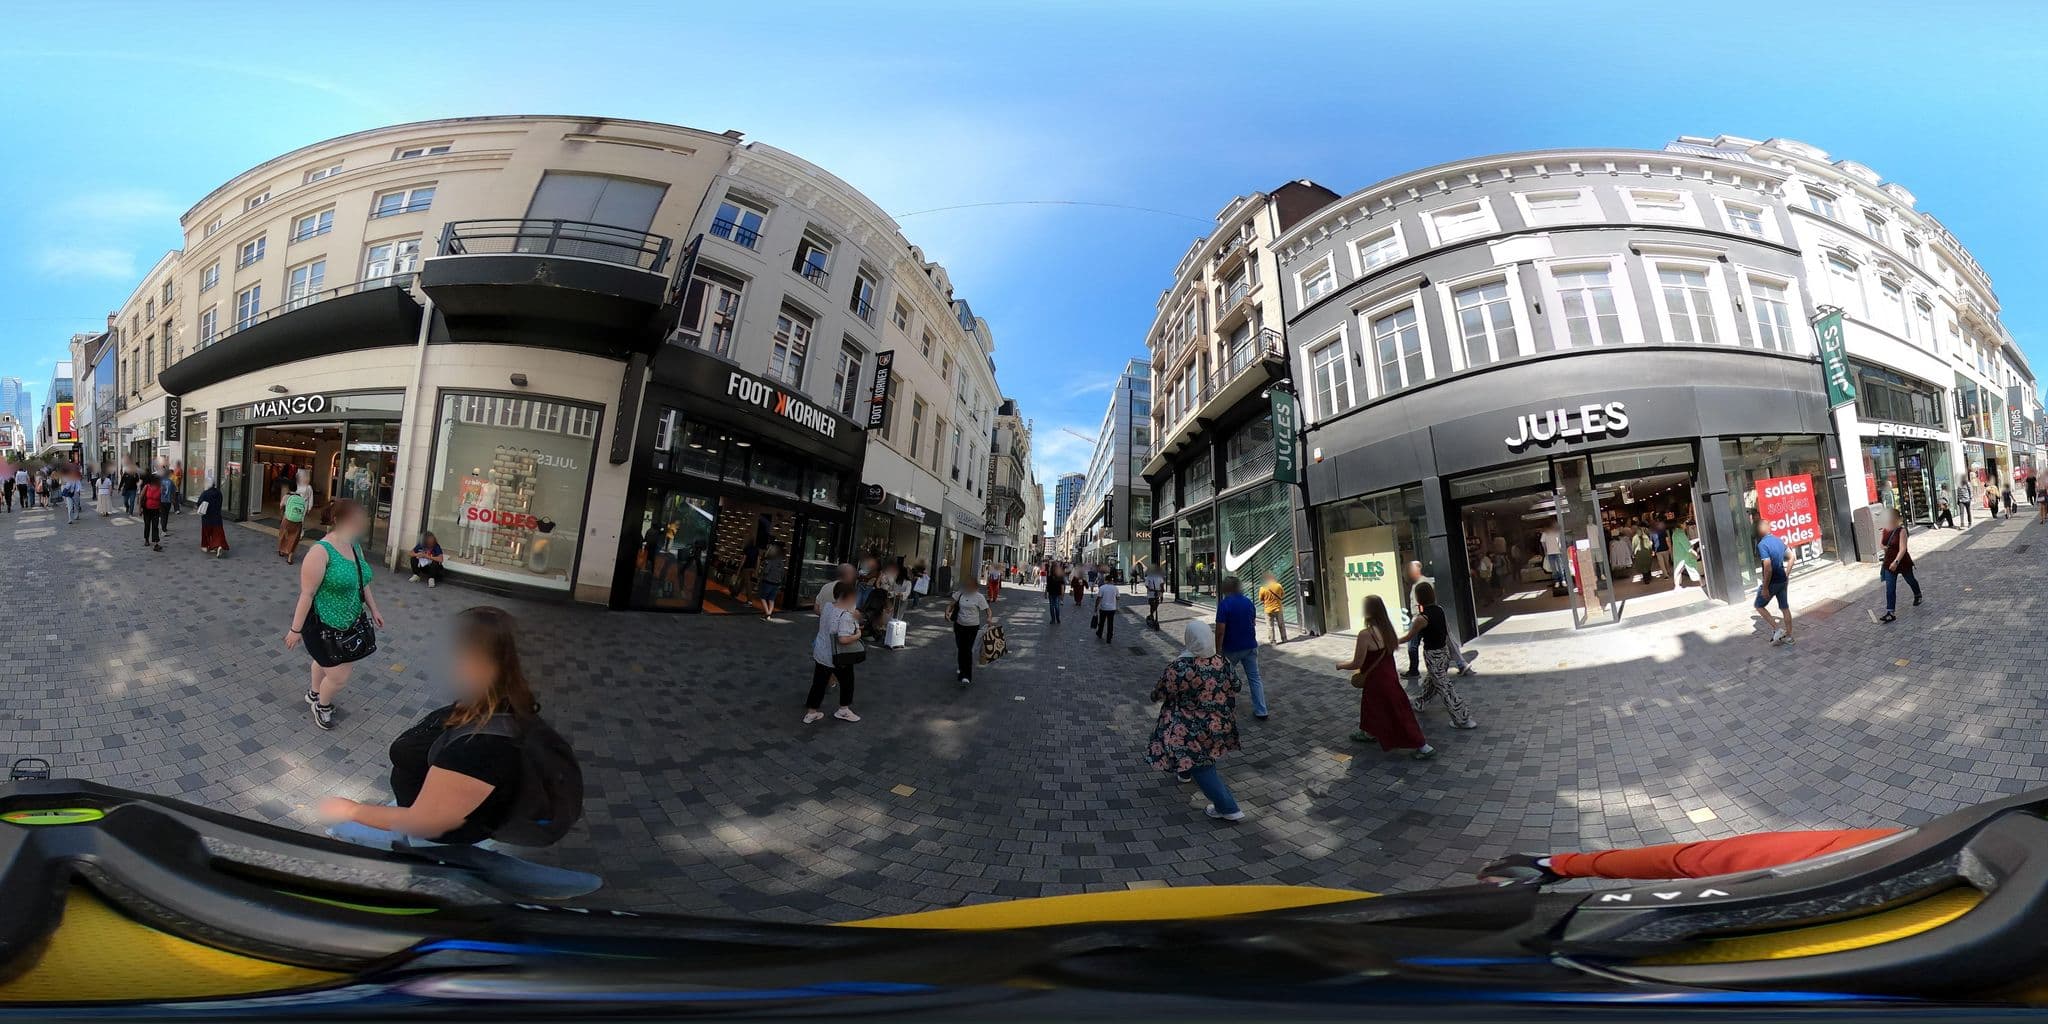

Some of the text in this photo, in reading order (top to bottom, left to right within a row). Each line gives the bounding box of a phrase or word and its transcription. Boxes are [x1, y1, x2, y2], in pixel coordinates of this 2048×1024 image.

[1823, 325, 1849, 391] JULES
[727, 372, 773, 409] FOOT
[253, 394, 325, 418] MANGO
[870, 405, 882, 425] FOOT
[170, 400, 178, 438] MANGO
[1504, 401, 1629, 446] JULES
[2011, 409, 2023, 436] snipes
[1276, 403, 1292, 471] JULES
[1764, 480, 1807, 498] soldes
[1767, 496, 1809, 514] soldes
[467, 507, 538, 530] SOLDES
[1770, 512, 1812, 532] soldes
[1780, 528, 1814, 545] oldes
[1786, 541, 1821, 564] LES
